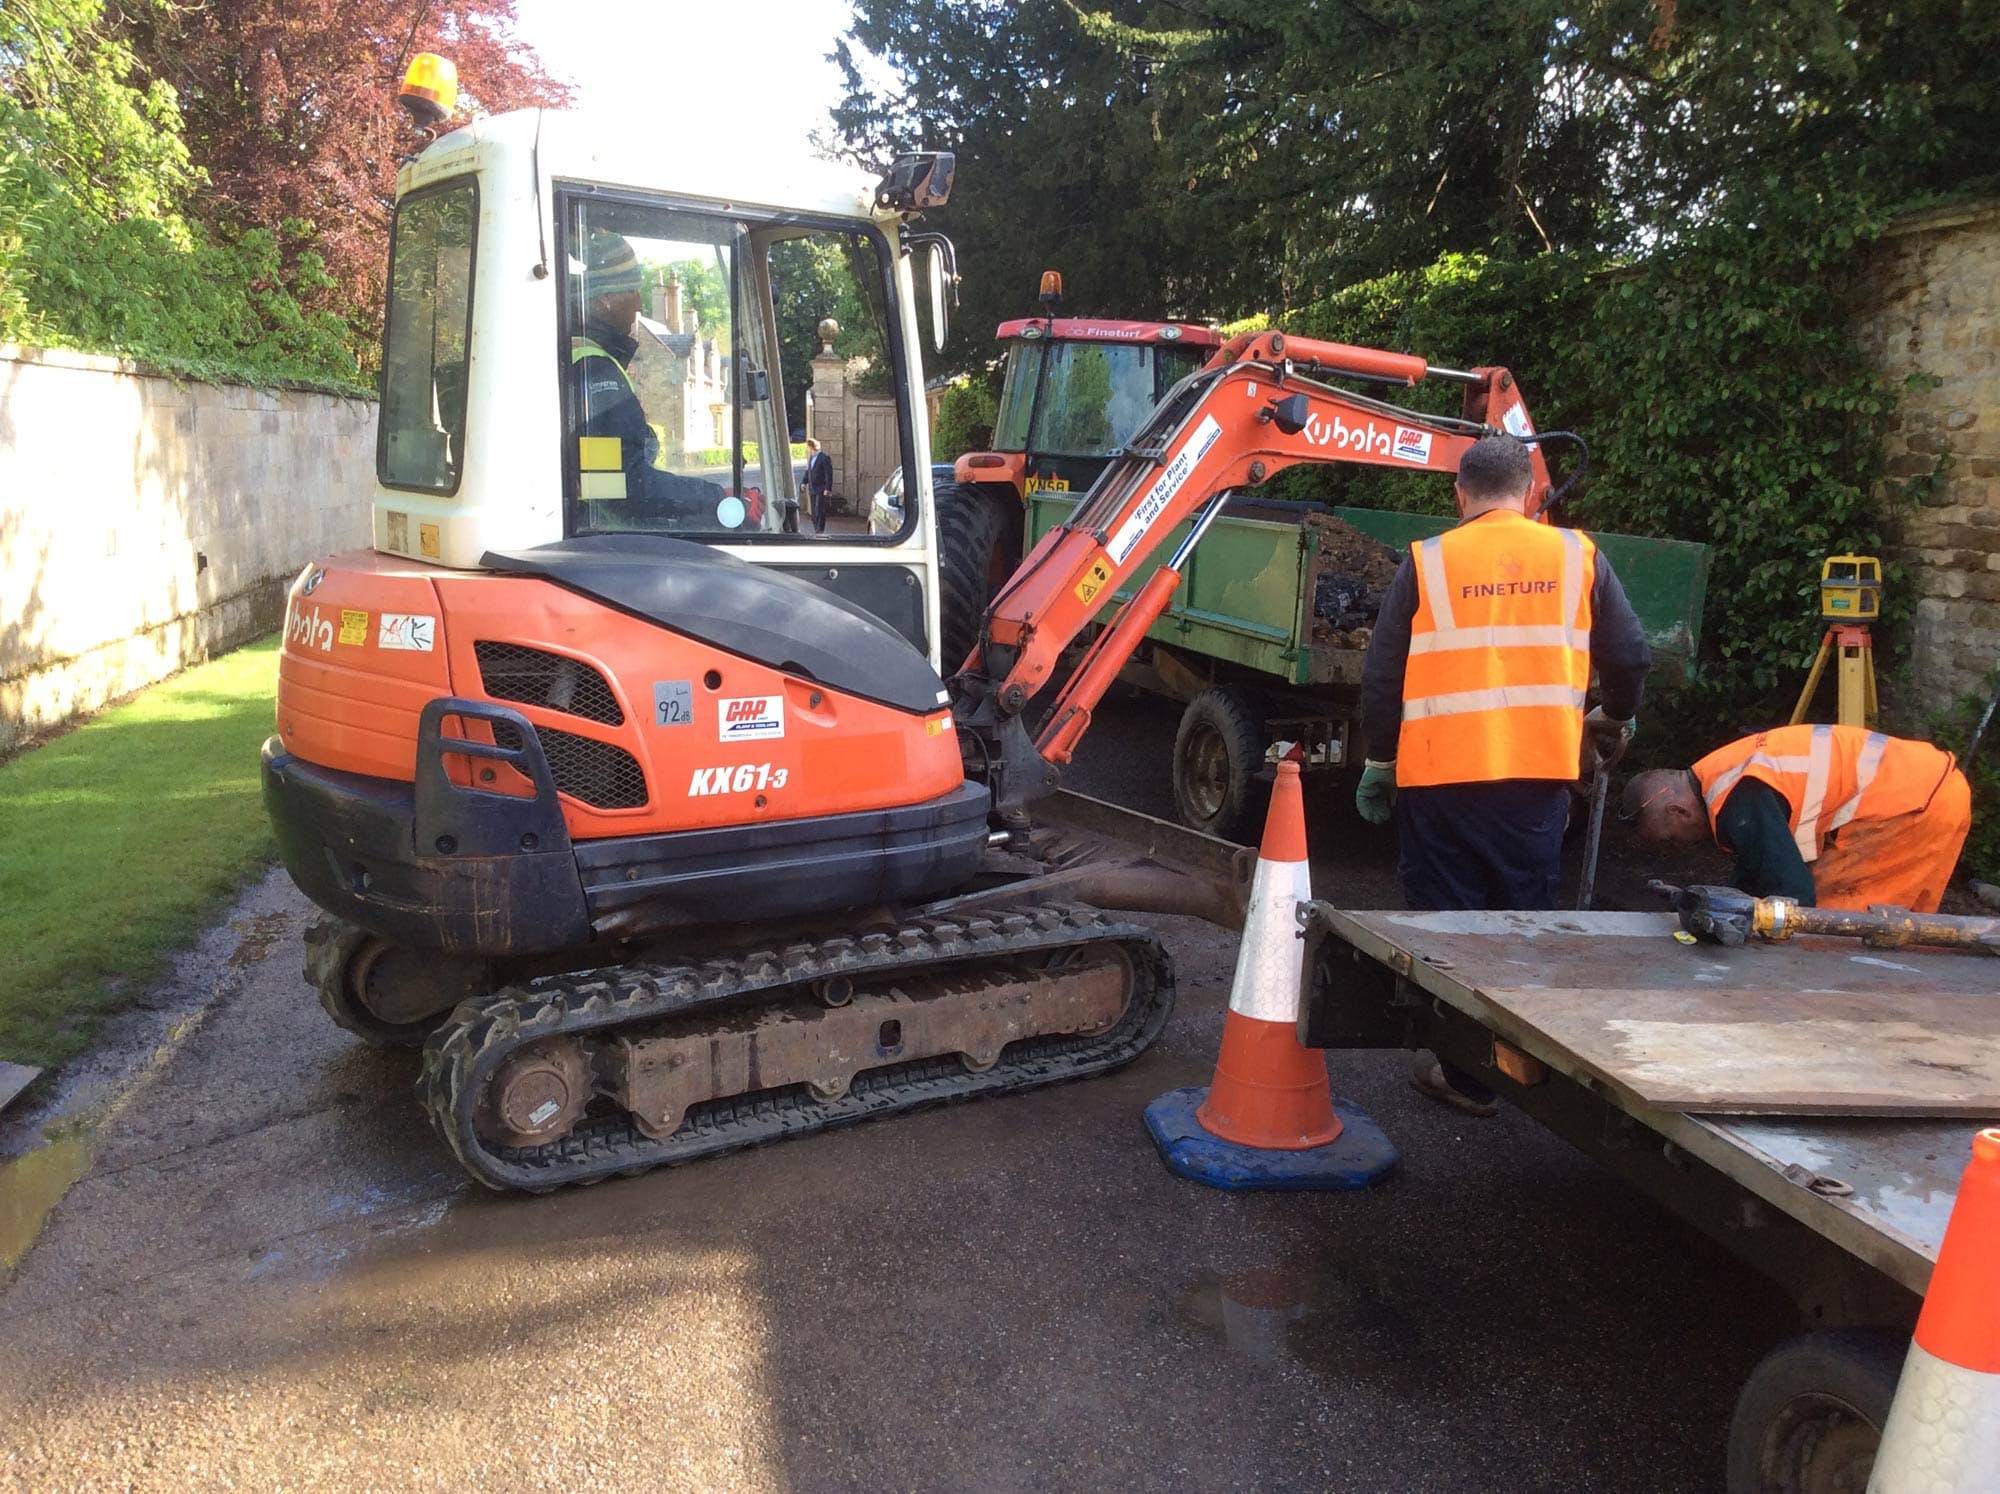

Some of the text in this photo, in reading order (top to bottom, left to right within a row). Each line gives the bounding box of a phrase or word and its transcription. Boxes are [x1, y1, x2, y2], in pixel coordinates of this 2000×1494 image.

[1086, 326, 1141, 338] Fineturf
[1302, 412, 1392, 456] Kubota
[1155, 479, 1167, 496] for
[1167, 452, 1188, 481] Plant
[1144, 502, 1160, 525] and
[1462, 580, 1558, 599] FINETURF
[687, 762, 789, 797] KX61-3
